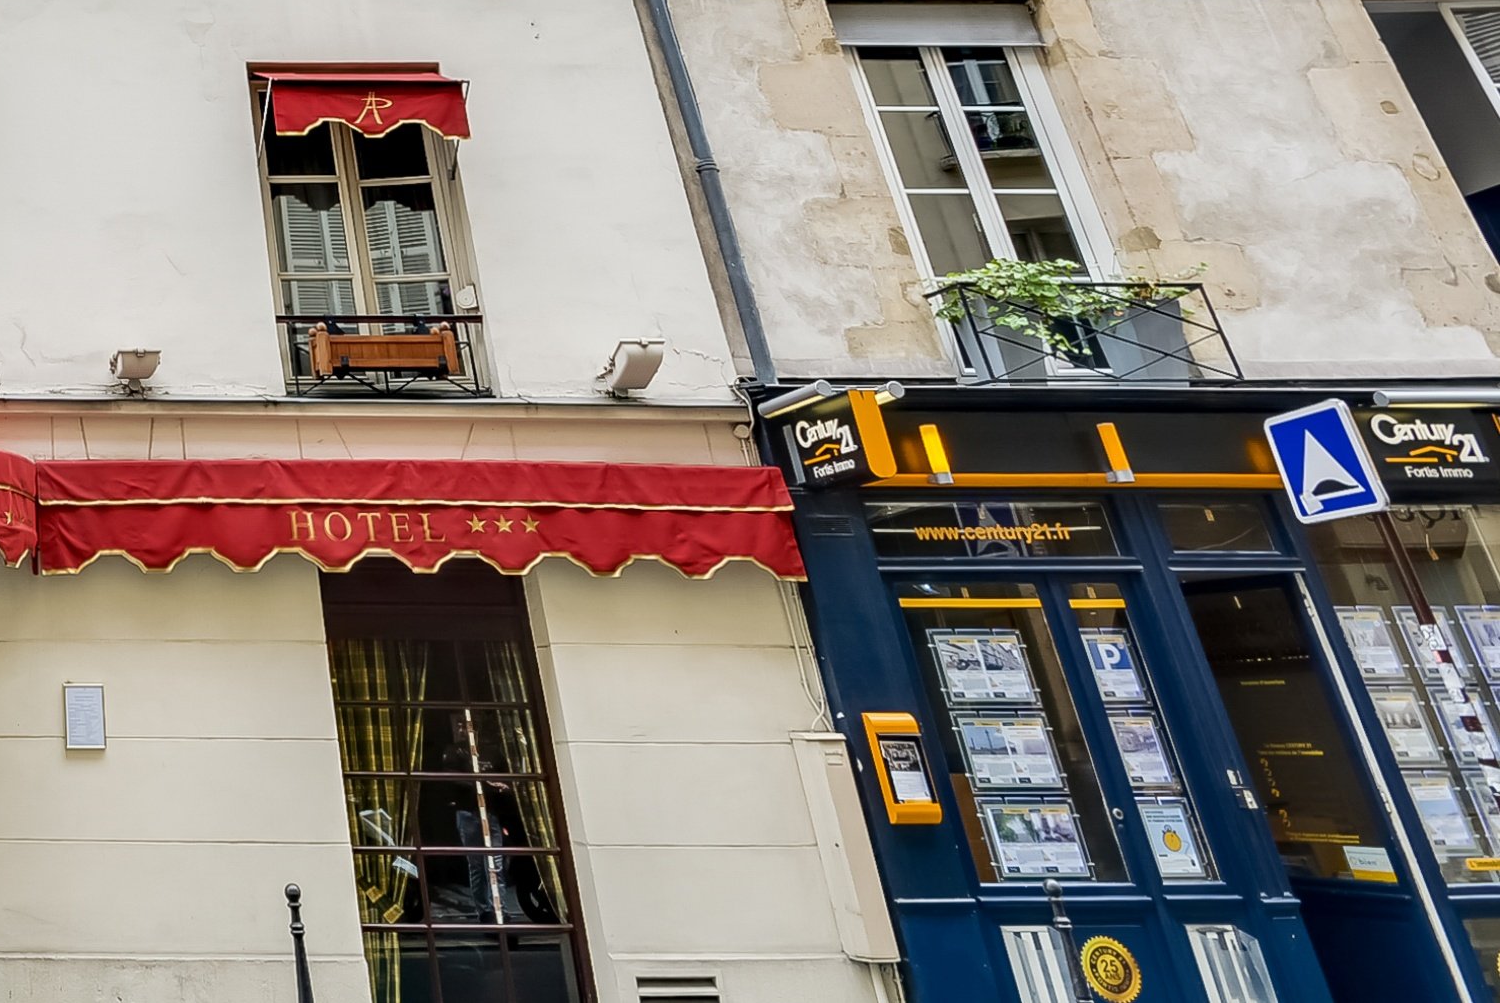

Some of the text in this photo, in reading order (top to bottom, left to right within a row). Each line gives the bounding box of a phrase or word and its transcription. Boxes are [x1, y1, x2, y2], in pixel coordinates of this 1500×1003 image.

[795, 418, 857, 454] Century 21
[1371, 413, 1488, 462] Century 21
[813, 459, 855, 478] Fortis Immo
[1404, 466, 1474, 478] Fortis Immo
[287, 510, 446, 543] HOTEL
[914, 523, 1071, 545] www.century21.fr
[1100, 959, 1119, 973] 25
